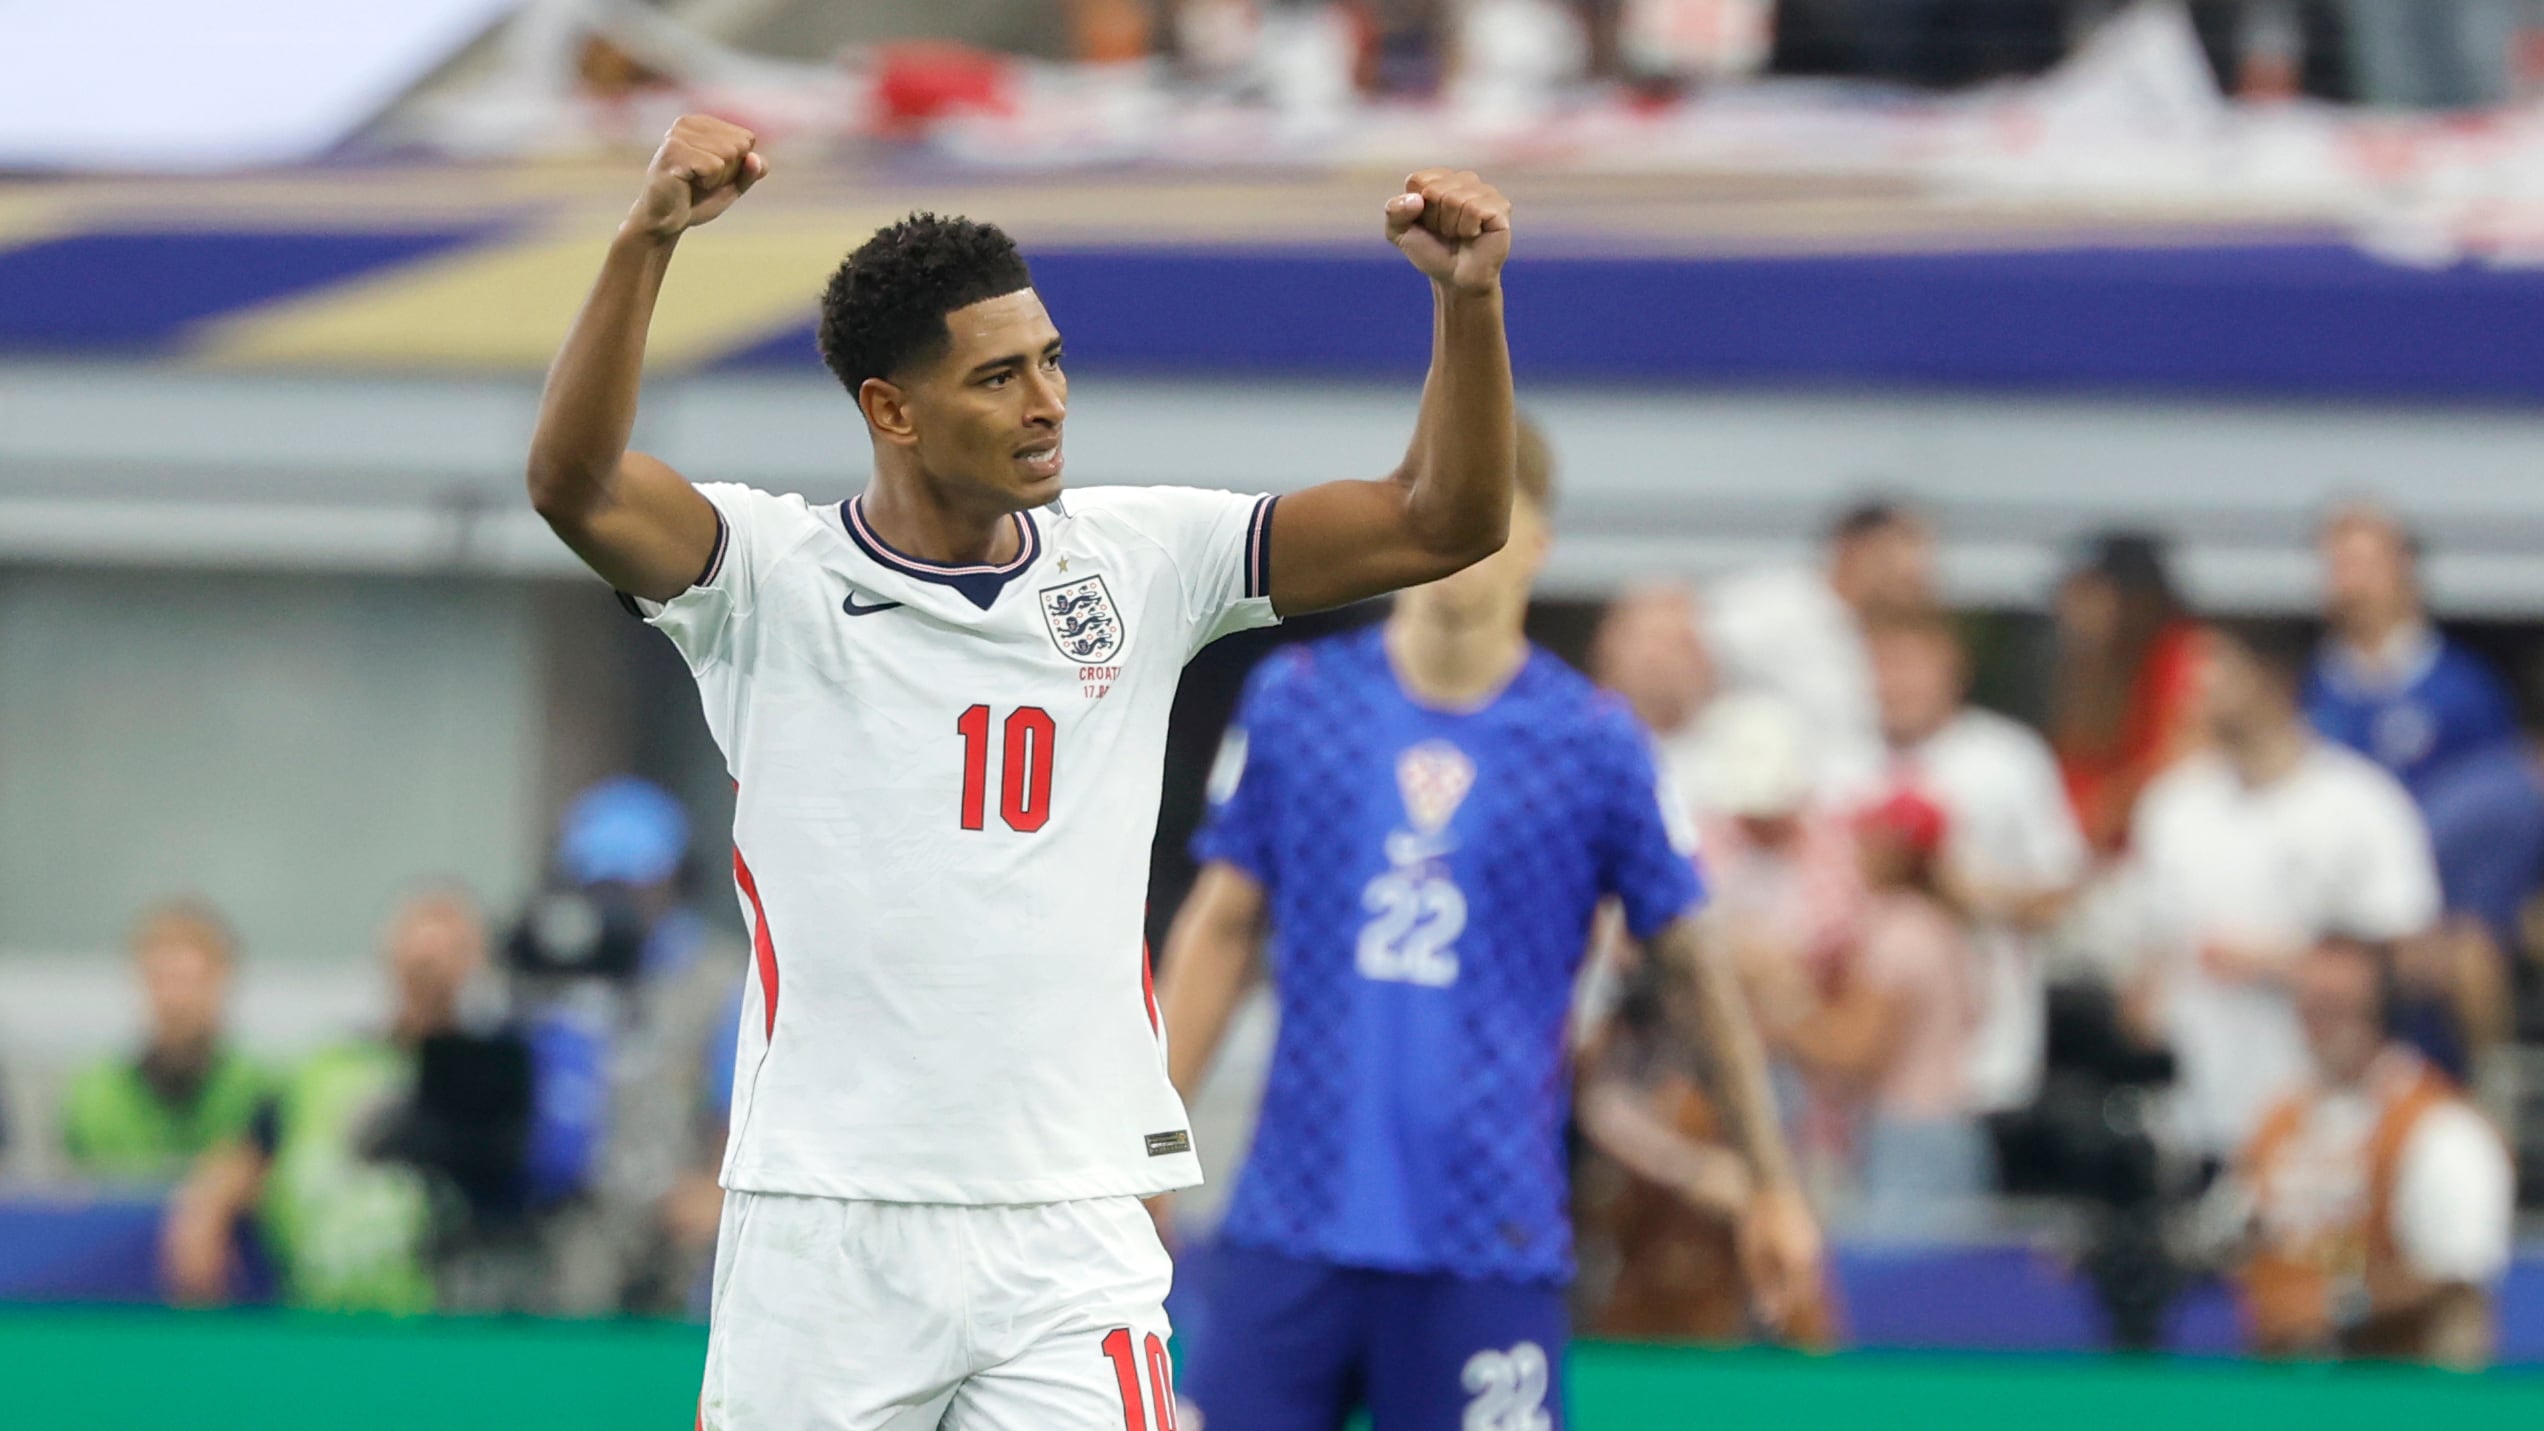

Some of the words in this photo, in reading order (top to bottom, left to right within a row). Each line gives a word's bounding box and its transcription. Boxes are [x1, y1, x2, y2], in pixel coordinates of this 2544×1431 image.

[957, 704, 1056, 833] 10
[1355, 869, 1468, 988] 22
[1101, 1327, 1178, 1431] 10
[1460, 1341, 1552, 1431] 22
